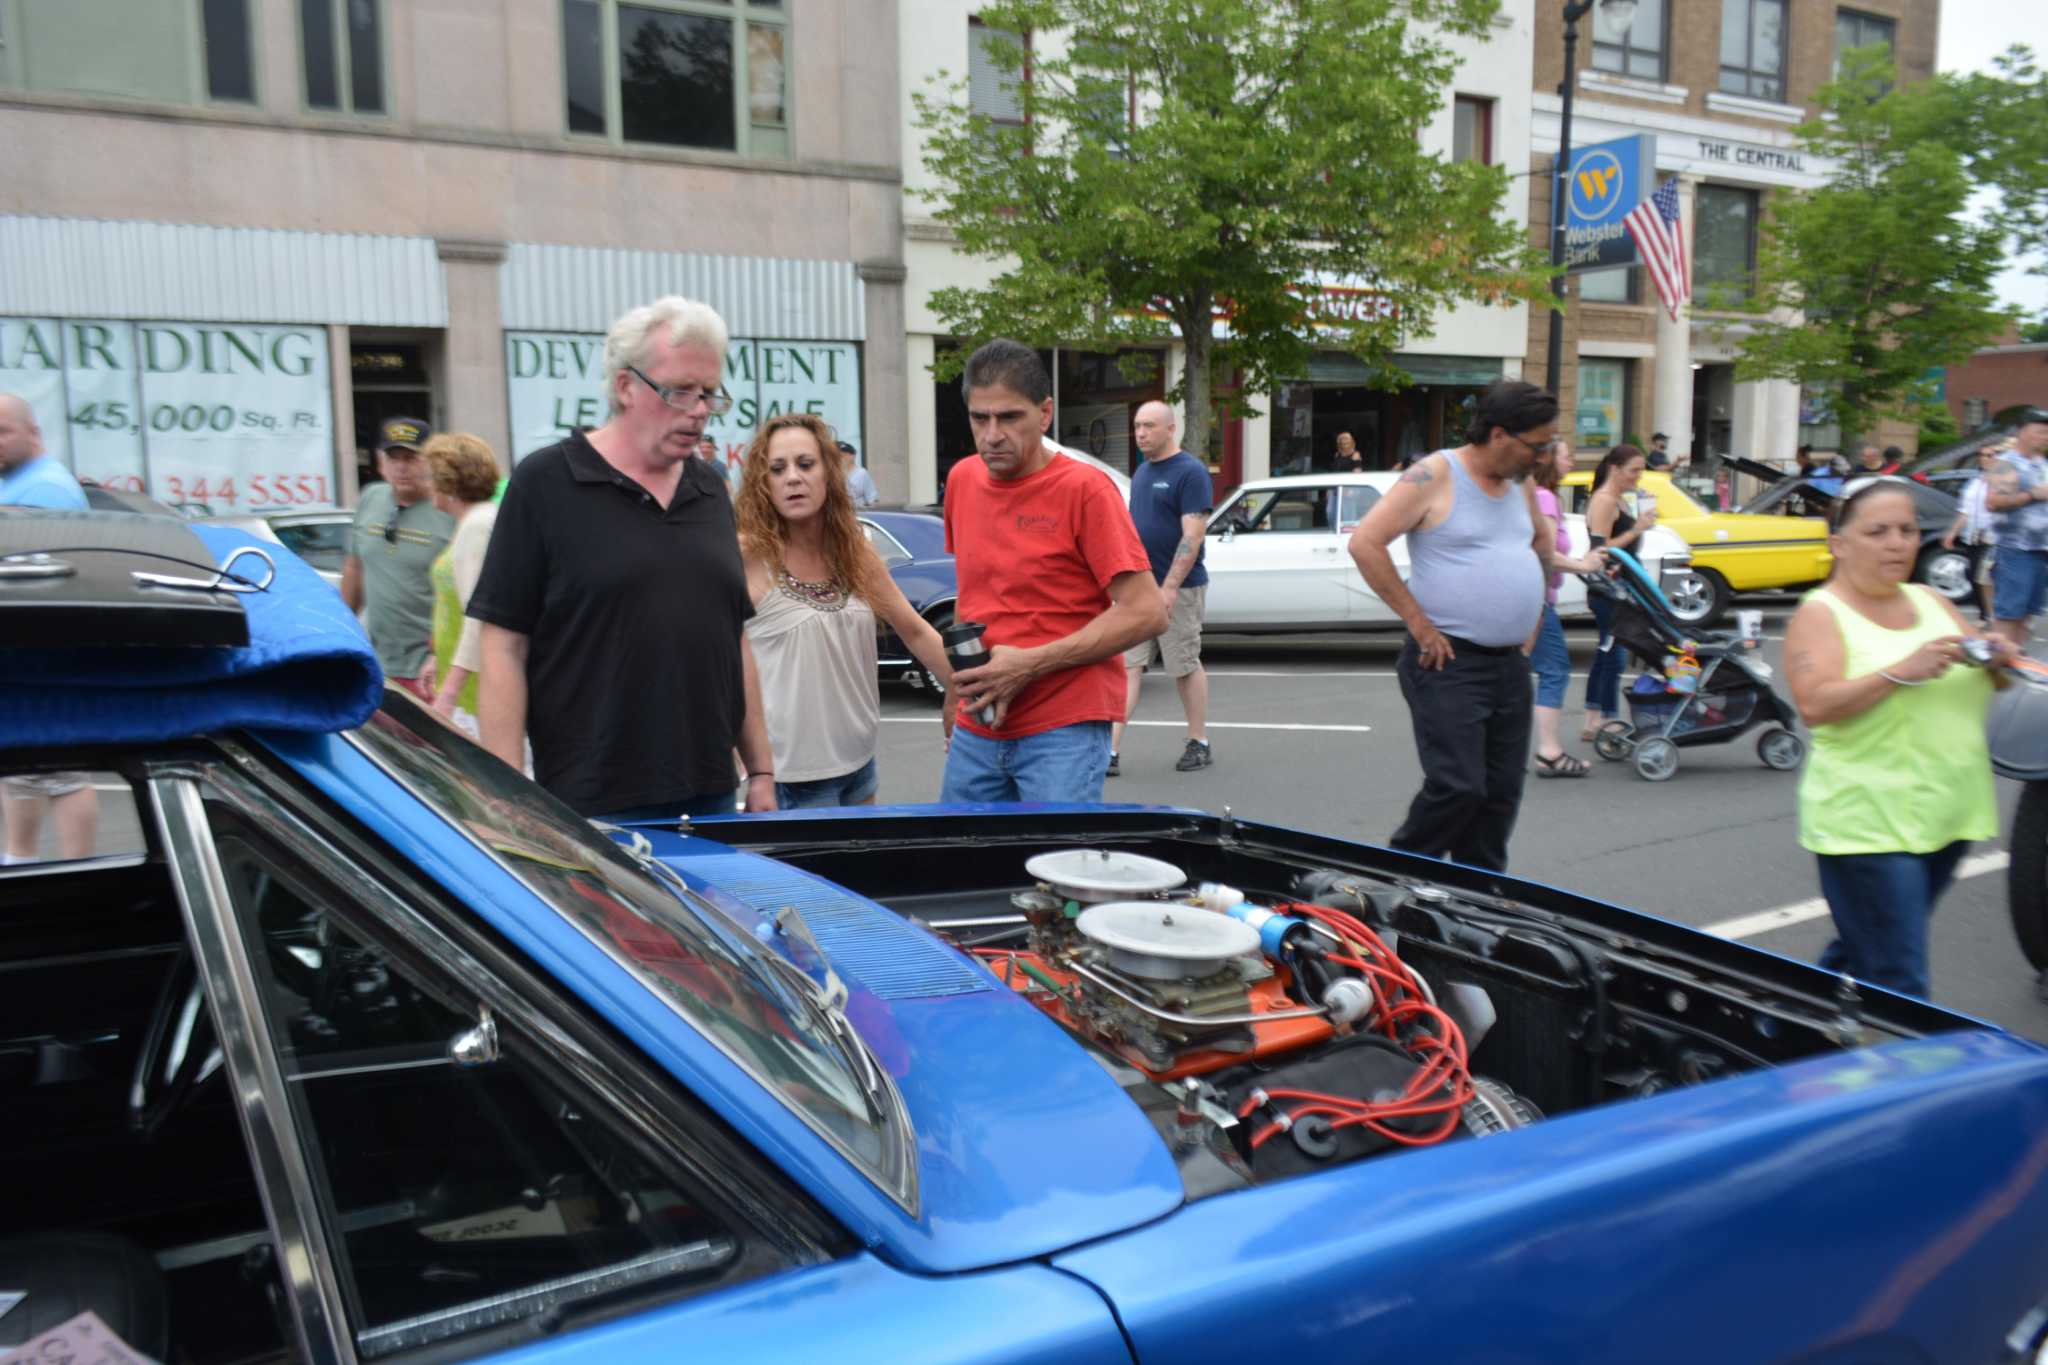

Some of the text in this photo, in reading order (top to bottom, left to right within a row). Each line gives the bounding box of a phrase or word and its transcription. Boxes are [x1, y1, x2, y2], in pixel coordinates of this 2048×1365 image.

[1698, 141, 1804, 172] THE CENTRAL
[1565, 223, 1625, 246] Webster
[242, 411, 284, 431] Sq.
[166, 474, 239, 507] 344
[248, 473, 331, 506] 5551
